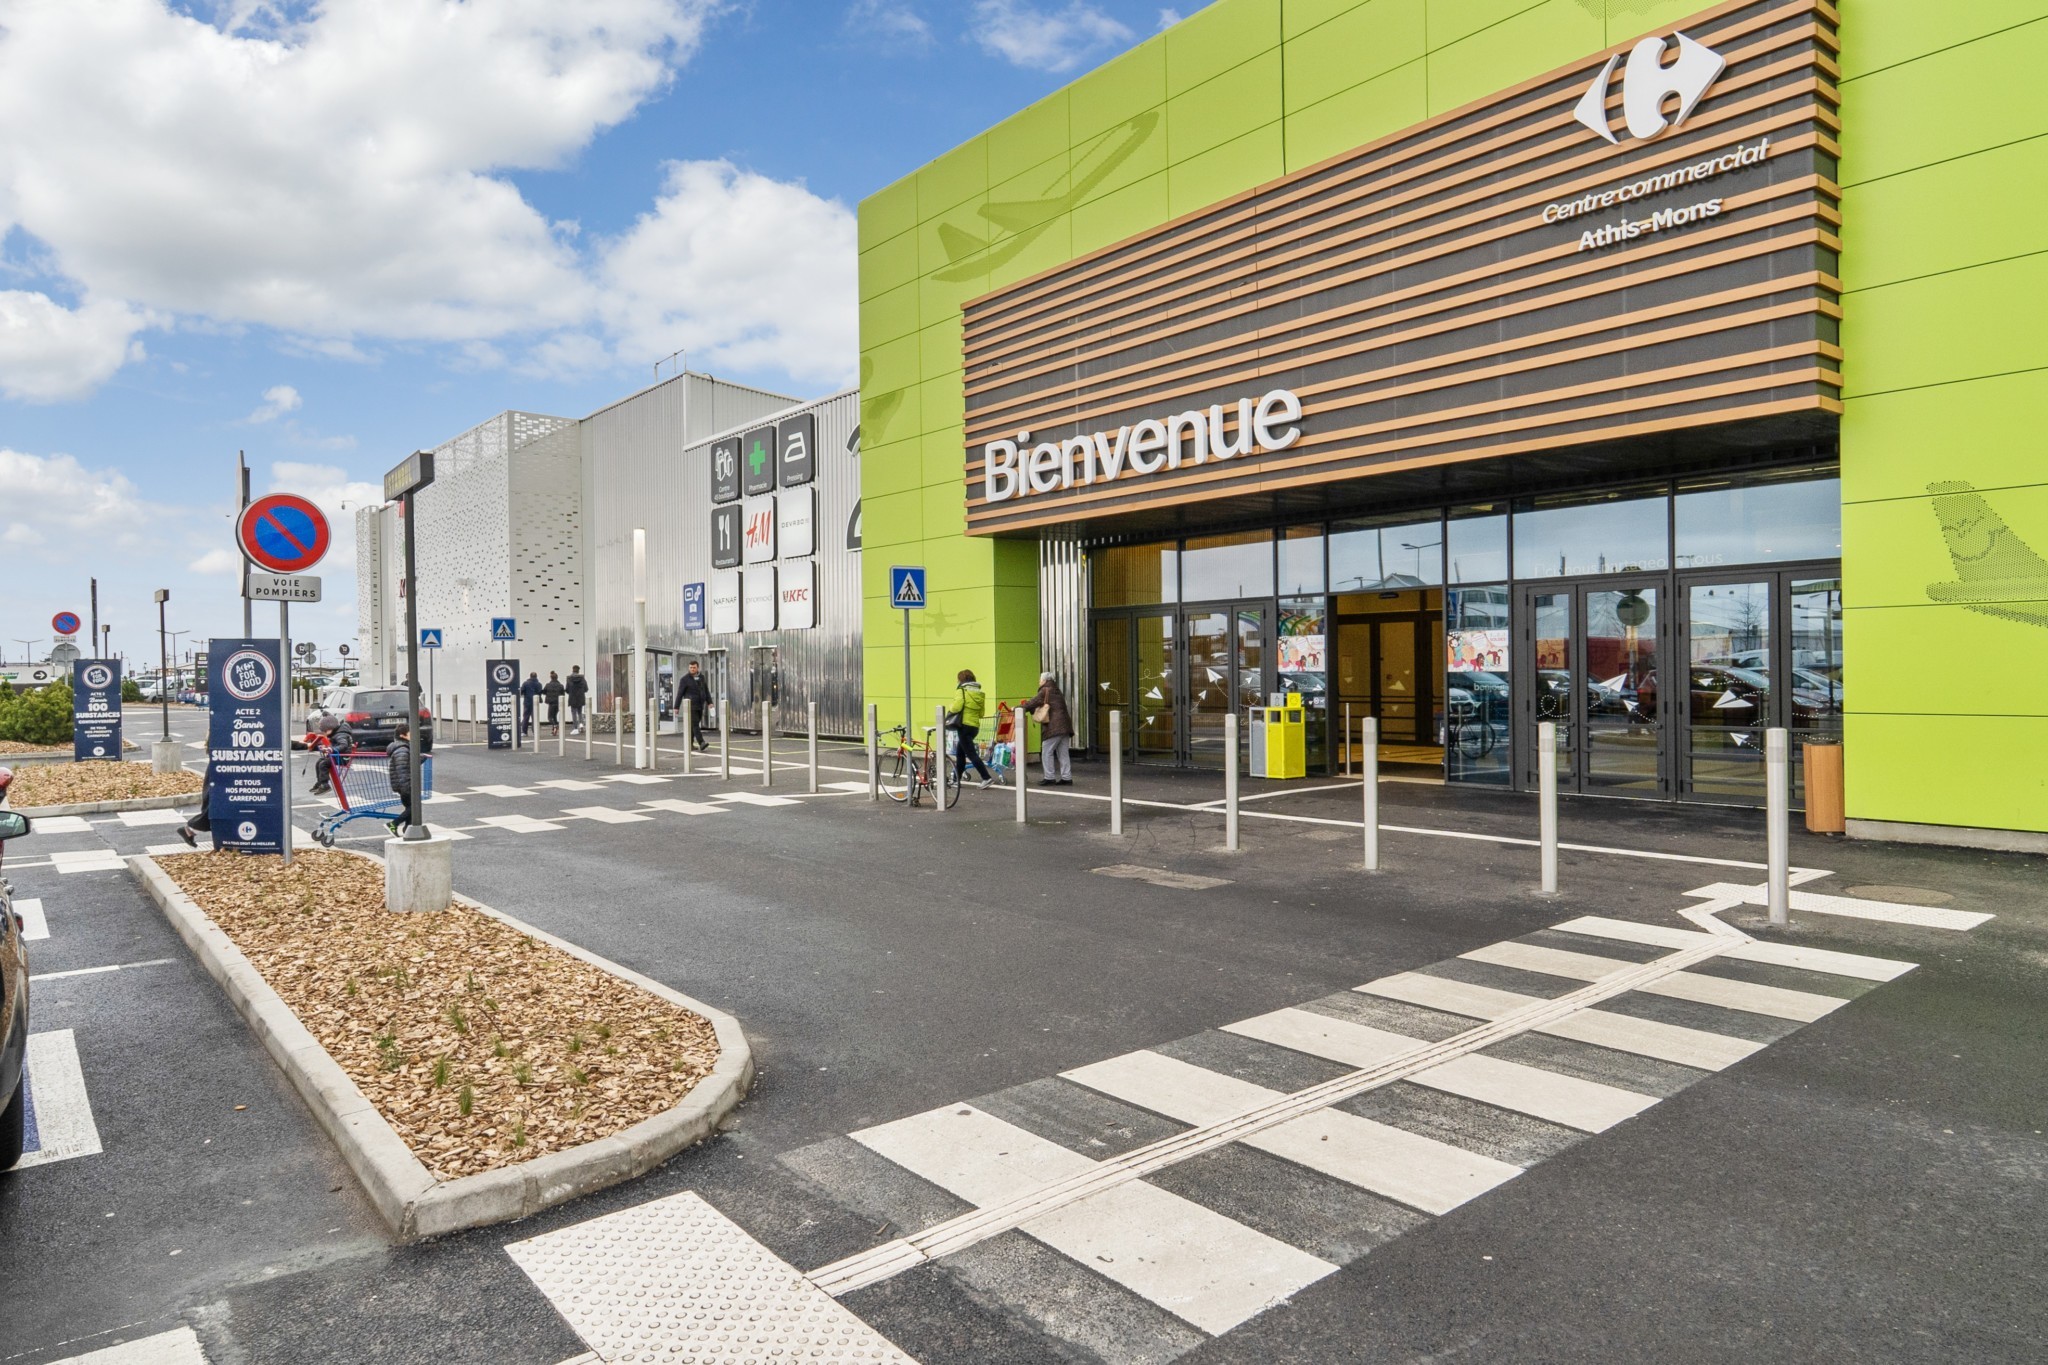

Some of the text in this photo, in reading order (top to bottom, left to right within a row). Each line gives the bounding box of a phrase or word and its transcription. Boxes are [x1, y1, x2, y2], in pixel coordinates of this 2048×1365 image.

[1542, 137, 1770, 224] Centre commercial
[1578, 198, 1724, 251] Athis-Mons
[984, 389, 1302, 502] Bienvenue
[746, 510, 771, 549] H&M
[256, 588, 316, 597] POMPIERS
[788, 588, 808, 602] KFC
[239, 670, 256, 680] FOR
[239, 676, 261, 690] FOOD
[88, 703, 108, 712] 100
[233, 719, 264, 729] Bannir
[231, 731, 264, 747] 100
